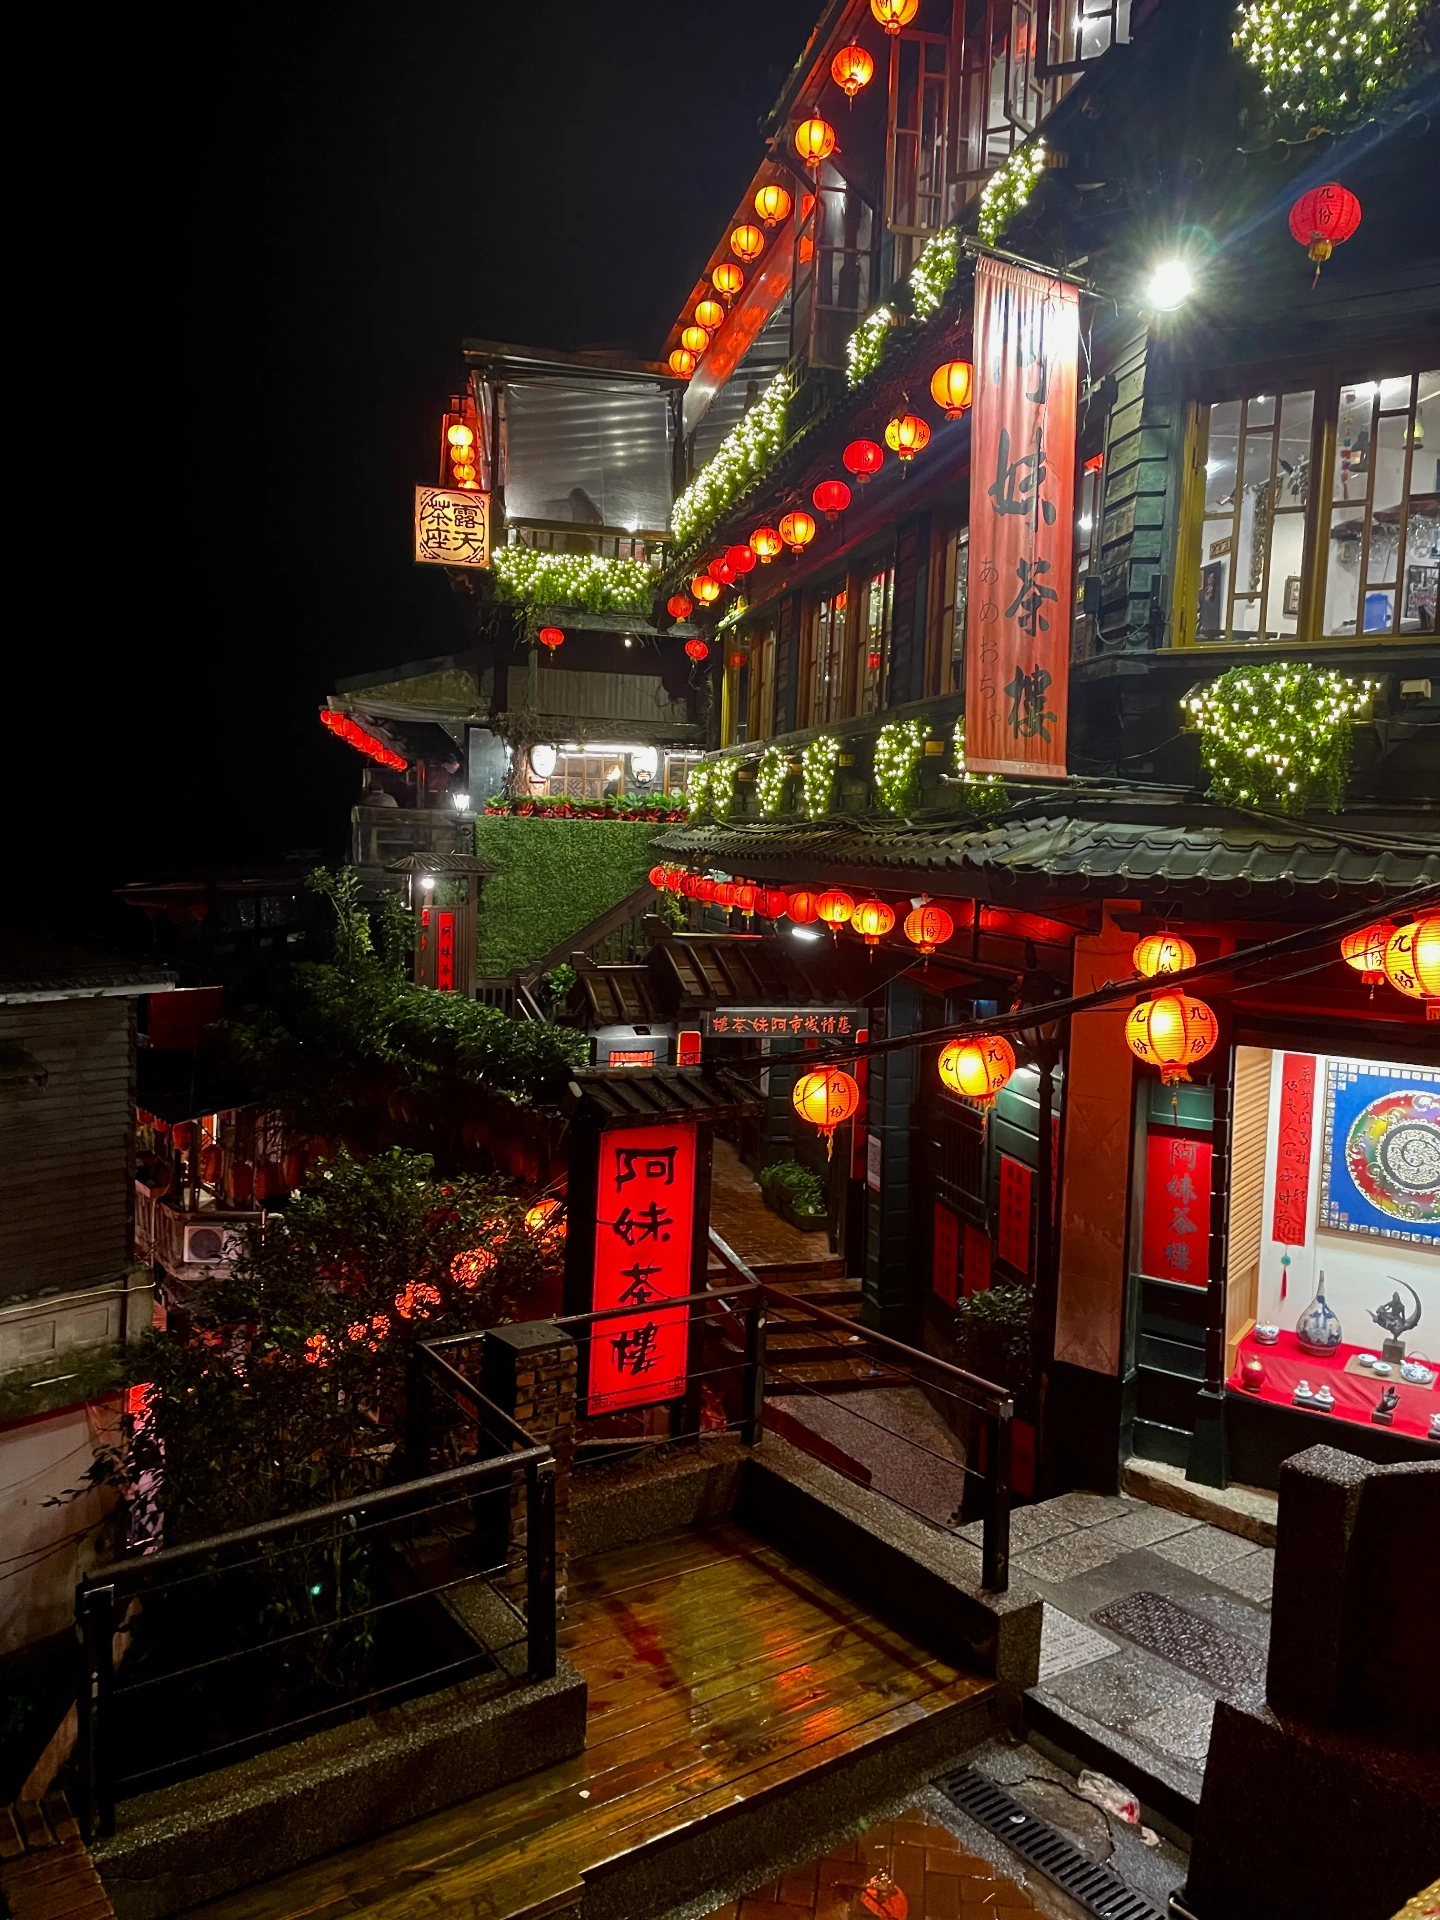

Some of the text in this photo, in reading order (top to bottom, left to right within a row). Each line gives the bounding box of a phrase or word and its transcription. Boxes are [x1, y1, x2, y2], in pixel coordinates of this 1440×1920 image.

[1318, 187, 1336, 225] 九份
[979, 556, 1002, 731] あめおちゃ
[925, 911, 937, 938] 九份
[1391, 934, 1416, 990] 九份
[1190, 1006, 1209, 1054] 九份
[986, 1048, 1007, 1089] 九份
[830, 1082, 847, 1118] 九份
[1164, 1139, 1200, 1273] 阿妹茶樓
[609, 1144, 680, 1377] 阿妹茶樓
